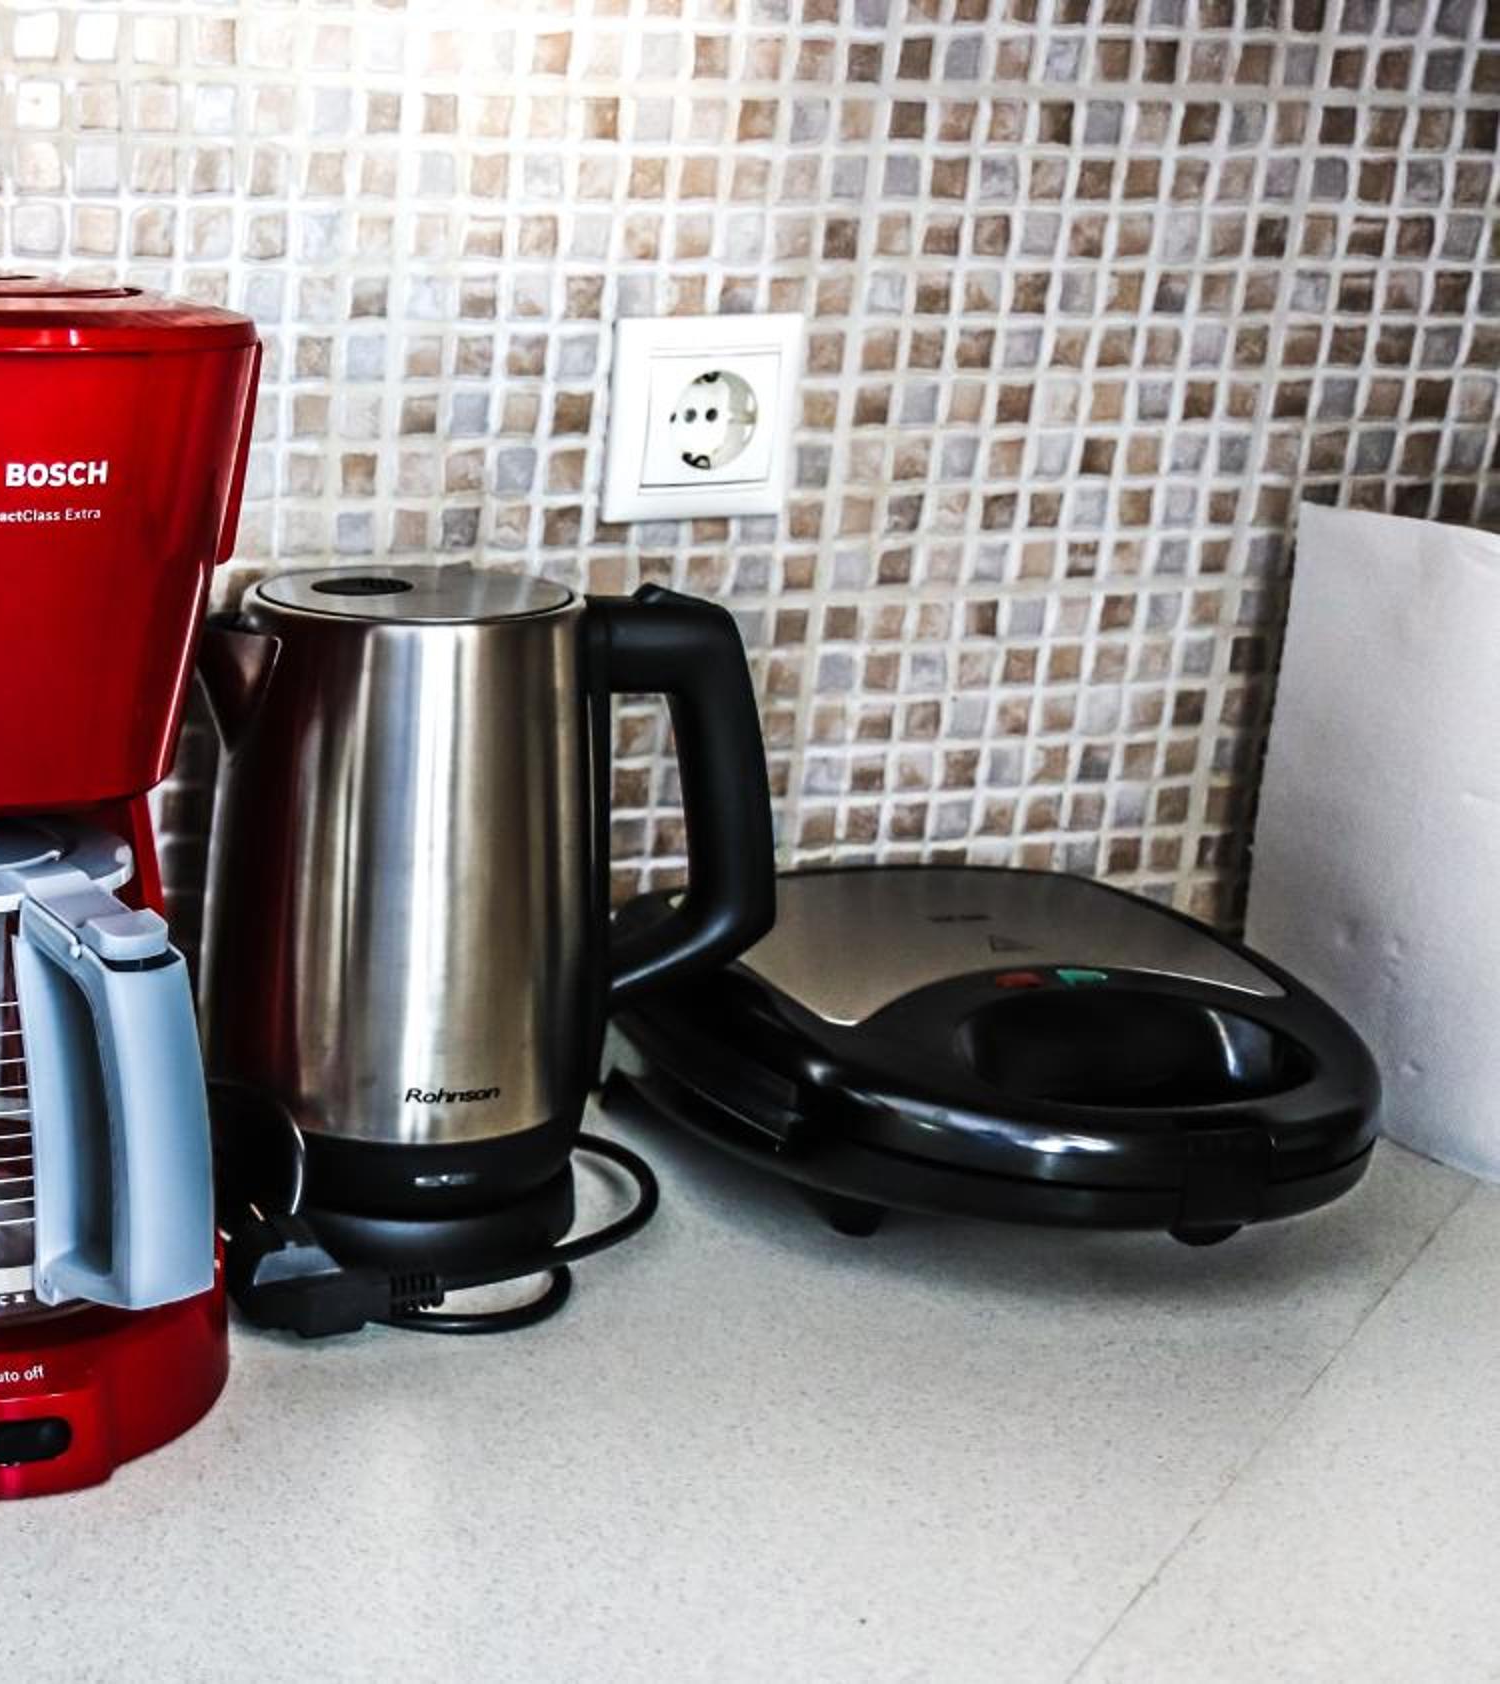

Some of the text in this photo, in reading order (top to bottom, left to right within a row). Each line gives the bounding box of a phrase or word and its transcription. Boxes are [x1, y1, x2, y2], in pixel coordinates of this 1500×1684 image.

[5, 461, 109, 488] BOSCH
[65, 507, 102, 521] Extra
[405, 1087, 501, 1104] Rohnson
[24, 1365, 44, 1382] off
